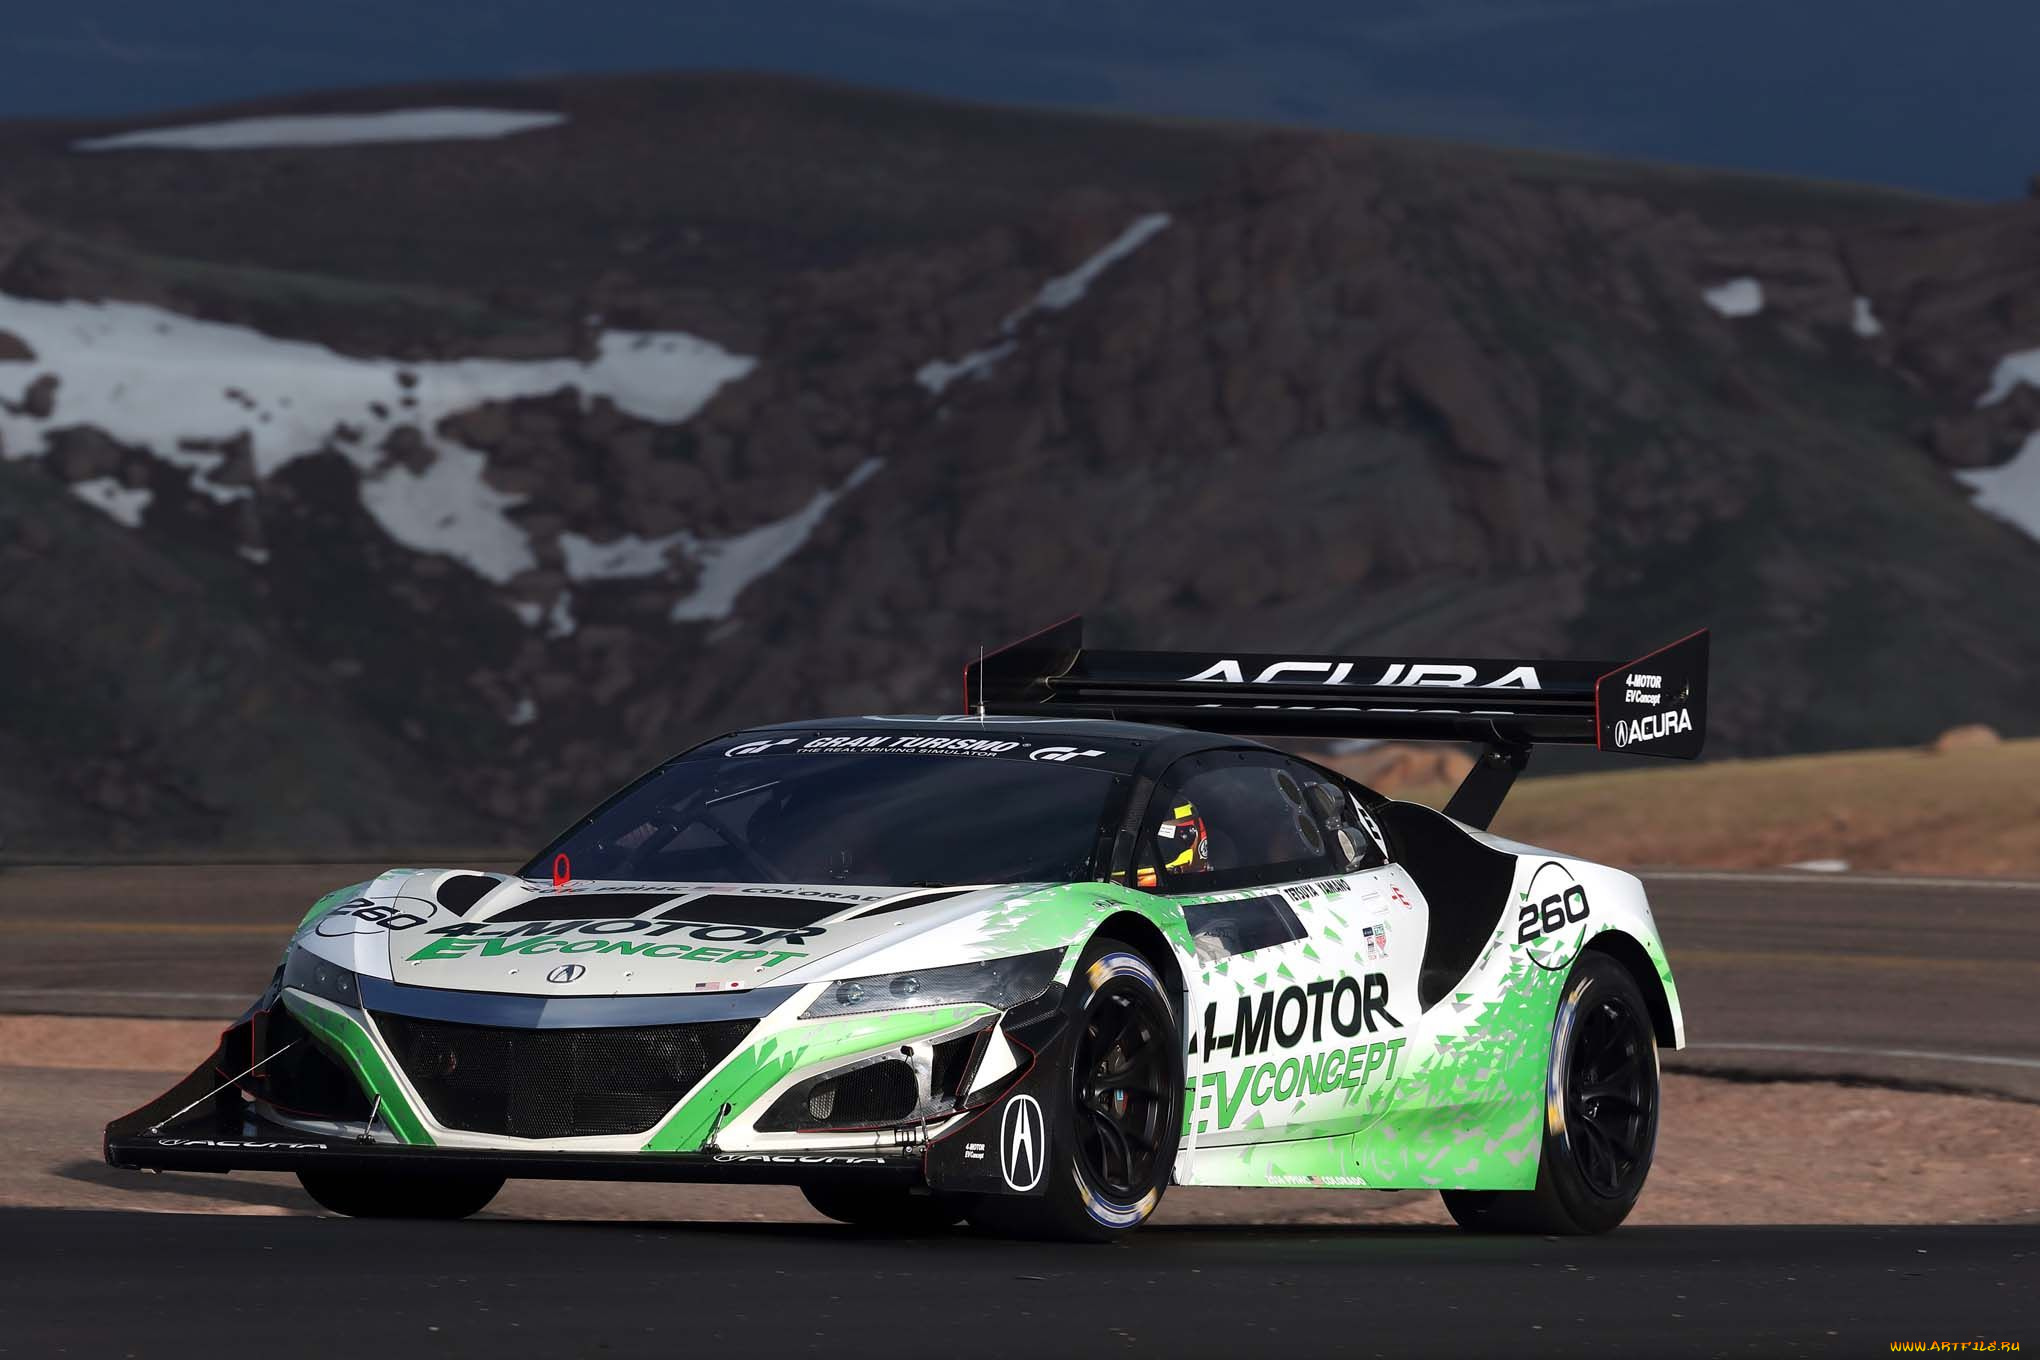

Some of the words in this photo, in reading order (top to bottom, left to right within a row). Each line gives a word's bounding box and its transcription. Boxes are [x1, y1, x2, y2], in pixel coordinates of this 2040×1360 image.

[1625, 674, 1662, 688] 4-MOTOR
[1628, 709, 1692, 744] ACURA
[803, 736, 892, 749] GRAN
[888, 736, 1020, 752] TURISMO
[918, 748, 998, 758] SIMULATOR
[742, 887, 883, 902] COLORAD
[1284, 883, 1320, 902] TETSUYA
[1315, 878, 1352, 895] YAMANO
[327, 897, 428, 931] 260
[1518, 884, 1590, 945] 260
[424, 918, 828, 946] 4-MOTOR
[1188, 973, 1405, 1063] 4-MOTOR
